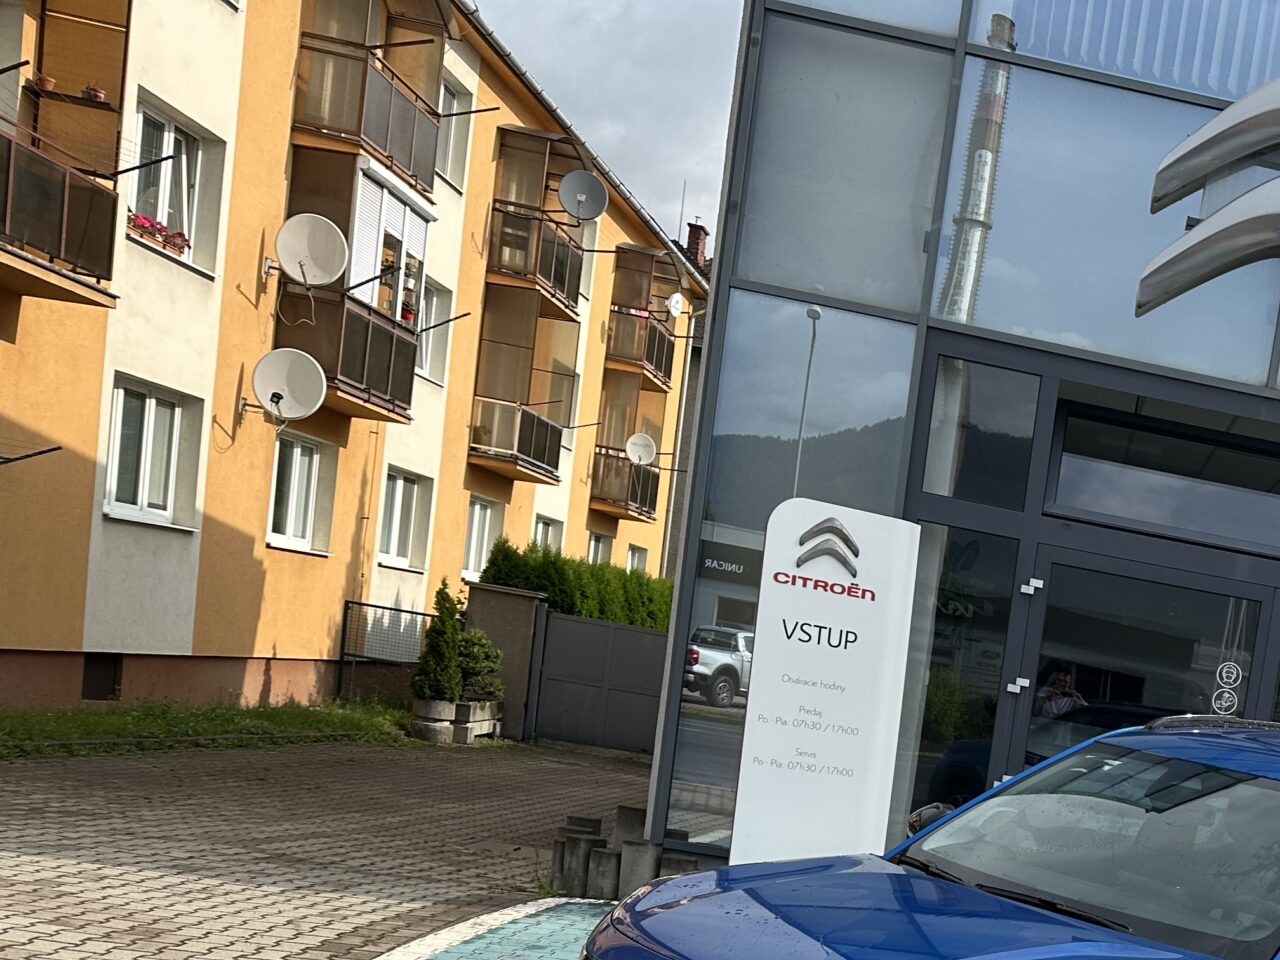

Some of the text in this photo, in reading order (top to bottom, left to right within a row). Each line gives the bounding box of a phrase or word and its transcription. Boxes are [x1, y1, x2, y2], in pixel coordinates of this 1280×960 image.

[772, 571, 876, 602] CITROËN
[782, 618, 858, 650] VSTUP
[781, 673, 846, 694] Otváracie hodiny
[799, 705, 823, 719] Predaj
[757, 714, 768, 723] Po
[792, 718, 822, 731] 07h30
[831, 724, 859, 736] 17h00
[794, 747, 817, 759] Servis
[752, 756, 764, 766] Po
[787, 760, 817, 773] 07h30
[826, 766, 854, 778] 17h00
